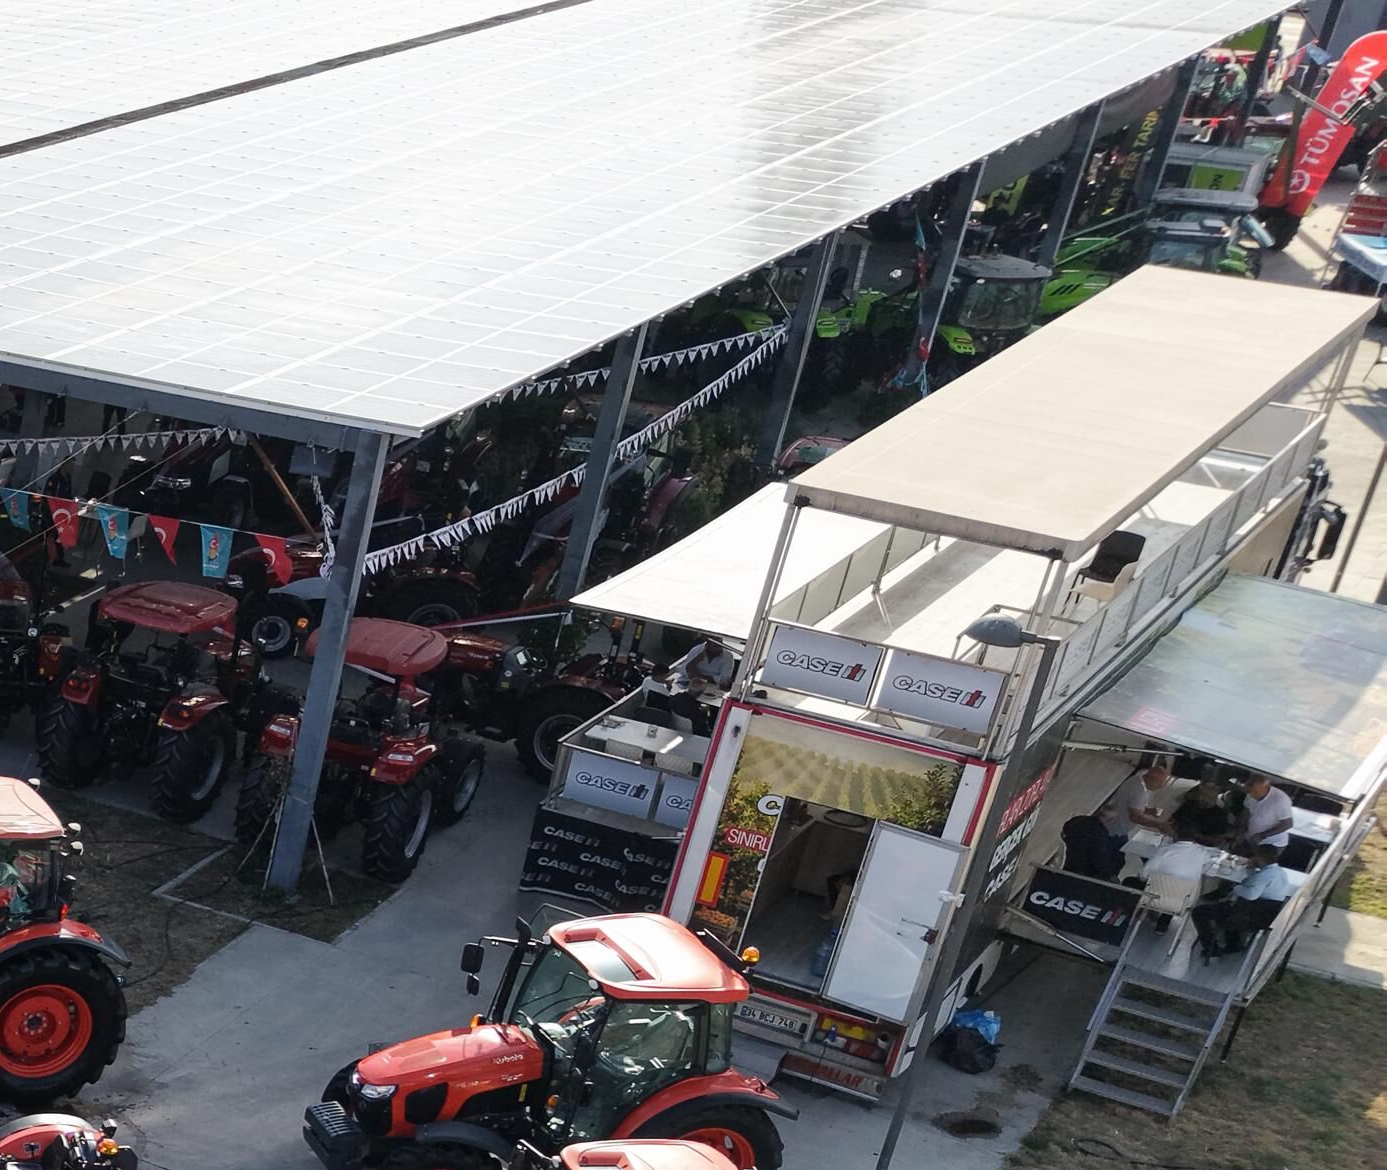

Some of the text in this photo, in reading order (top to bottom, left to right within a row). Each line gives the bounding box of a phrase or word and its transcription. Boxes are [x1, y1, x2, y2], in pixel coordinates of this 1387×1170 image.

[776, 649, 845, 677] CASE
[892, 675, 965, 703] CASE
[575, 771, 631, 797] CASE
[543, 825, 587, 845] CASE
[537, 856, 579, 874] CASE
[579, 852, 622, 871] CASE
[573, 882, 612, 901] CASE
[1029, 890, 1102, 921] CASE
